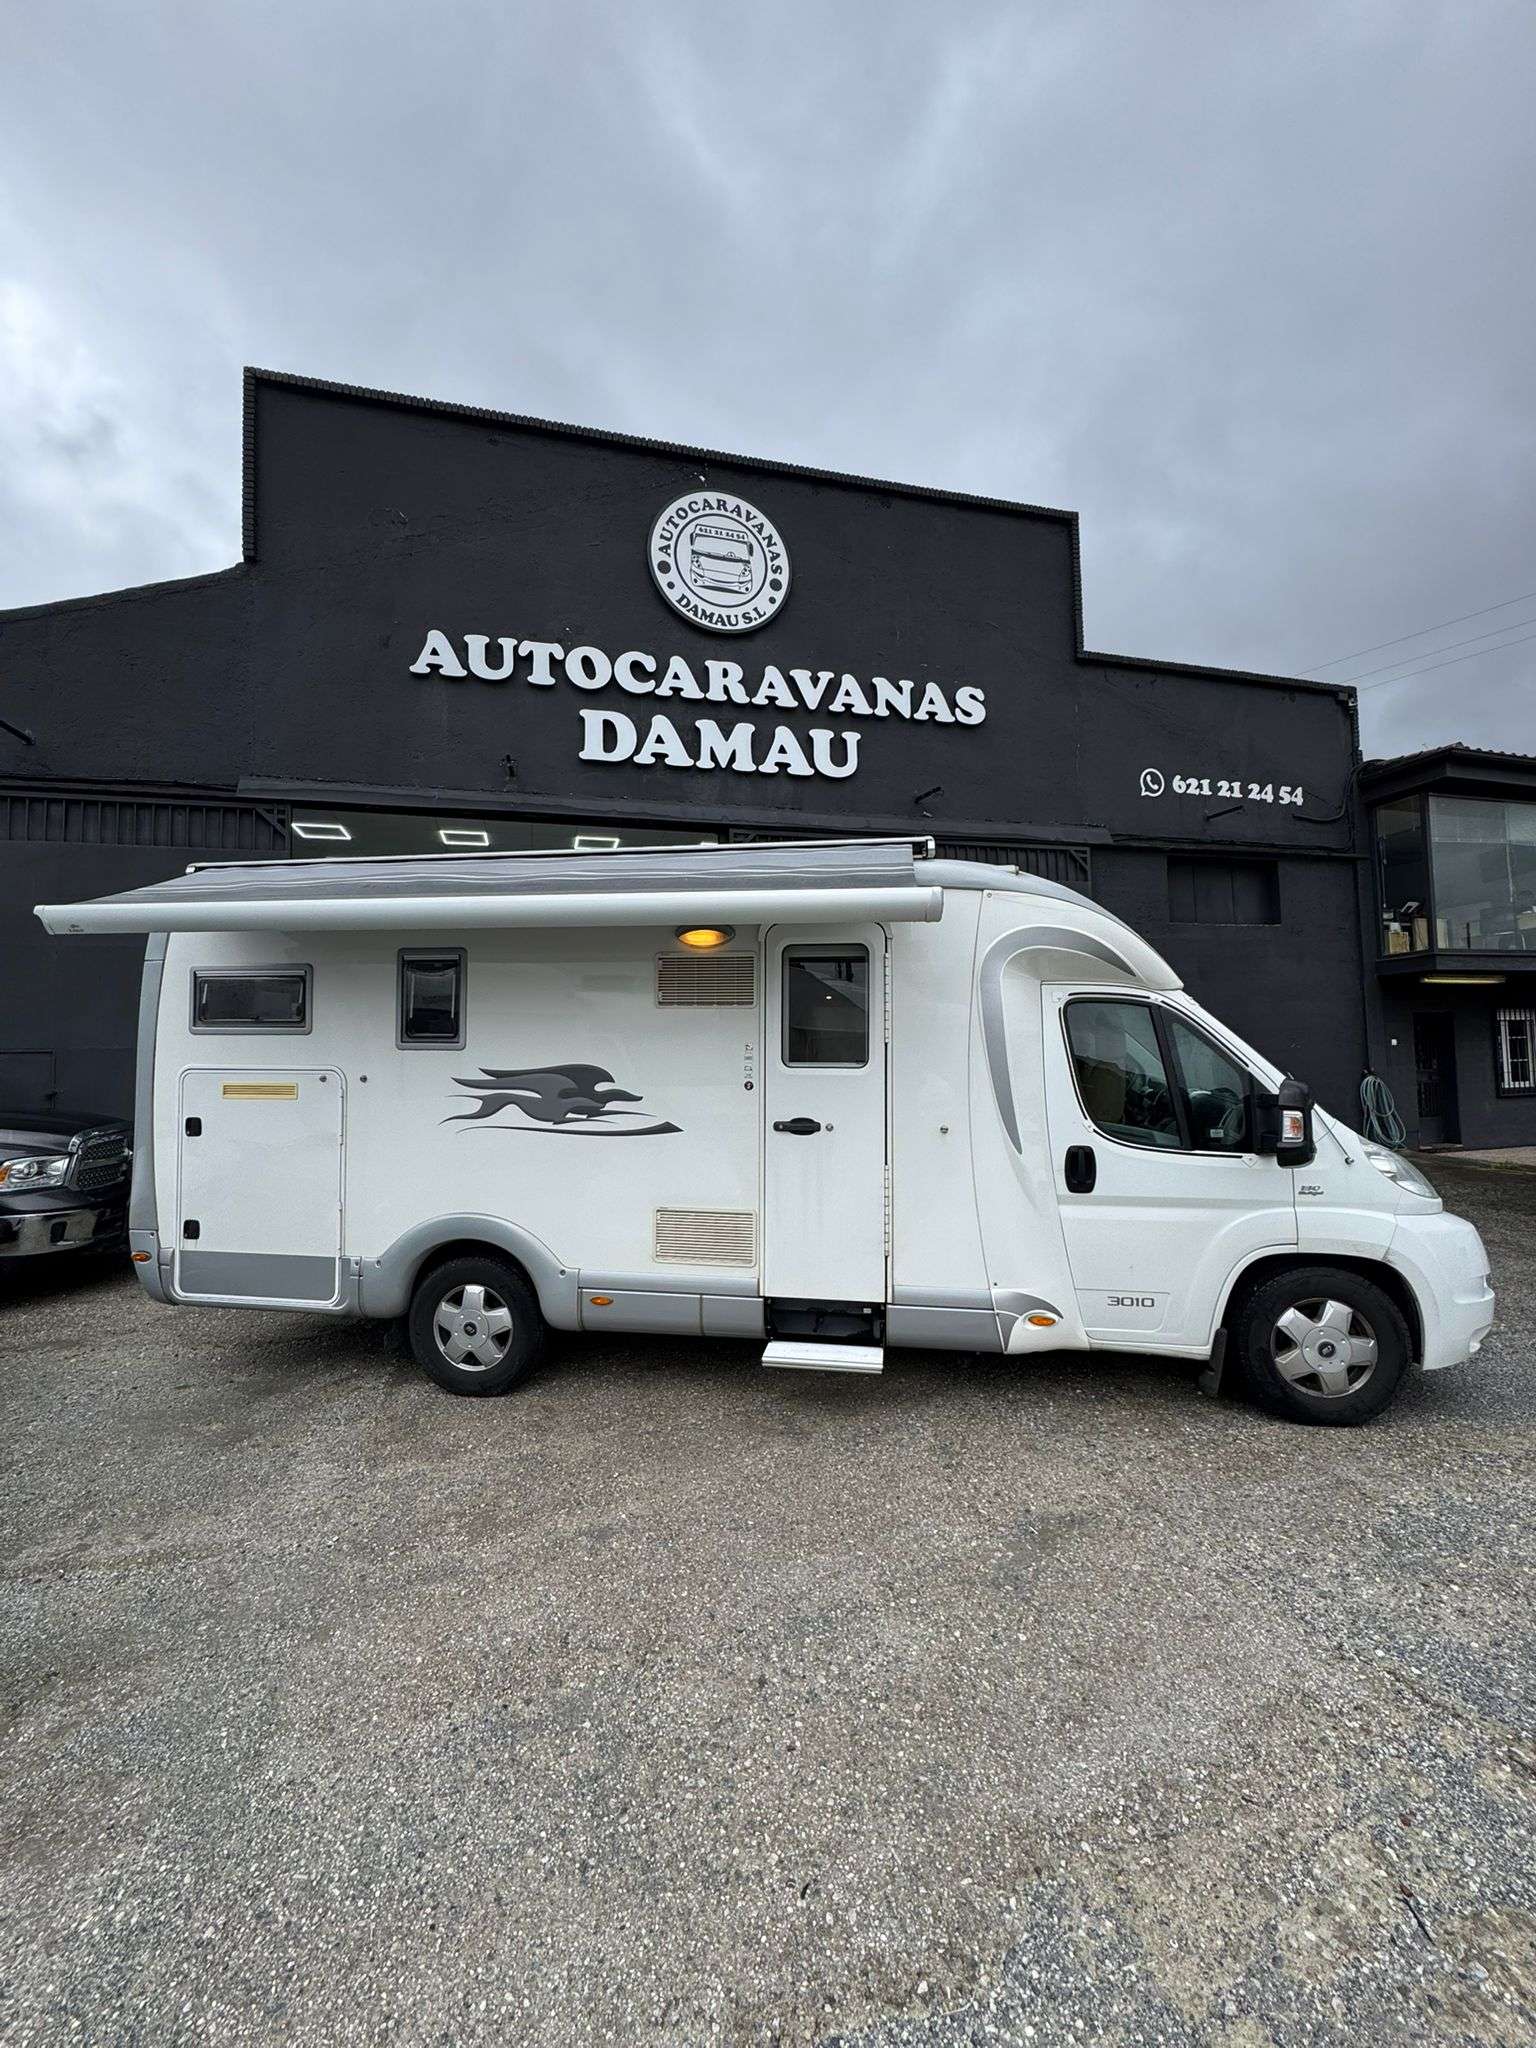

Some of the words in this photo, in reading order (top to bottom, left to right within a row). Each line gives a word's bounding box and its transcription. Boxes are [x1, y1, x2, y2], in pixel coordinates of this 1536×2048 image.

[658, 498, 782, 575] AUTOCARAVANAS
[676, 594, 739, 627] DAMAU
[743, 606, 766, 625] S.L
[409, 629, 987, 725] AUTOCARAVANAS
[579, 708, 862, 778] DAMAU
[1172, 774, 1213, 796] 621
[1217, 780, 1243, 798] 21
[1247, 783, 1274, 803] 24
[1278, 786, 1304, 806] 54
[1107, 1296, 1154, 1307] 3010
